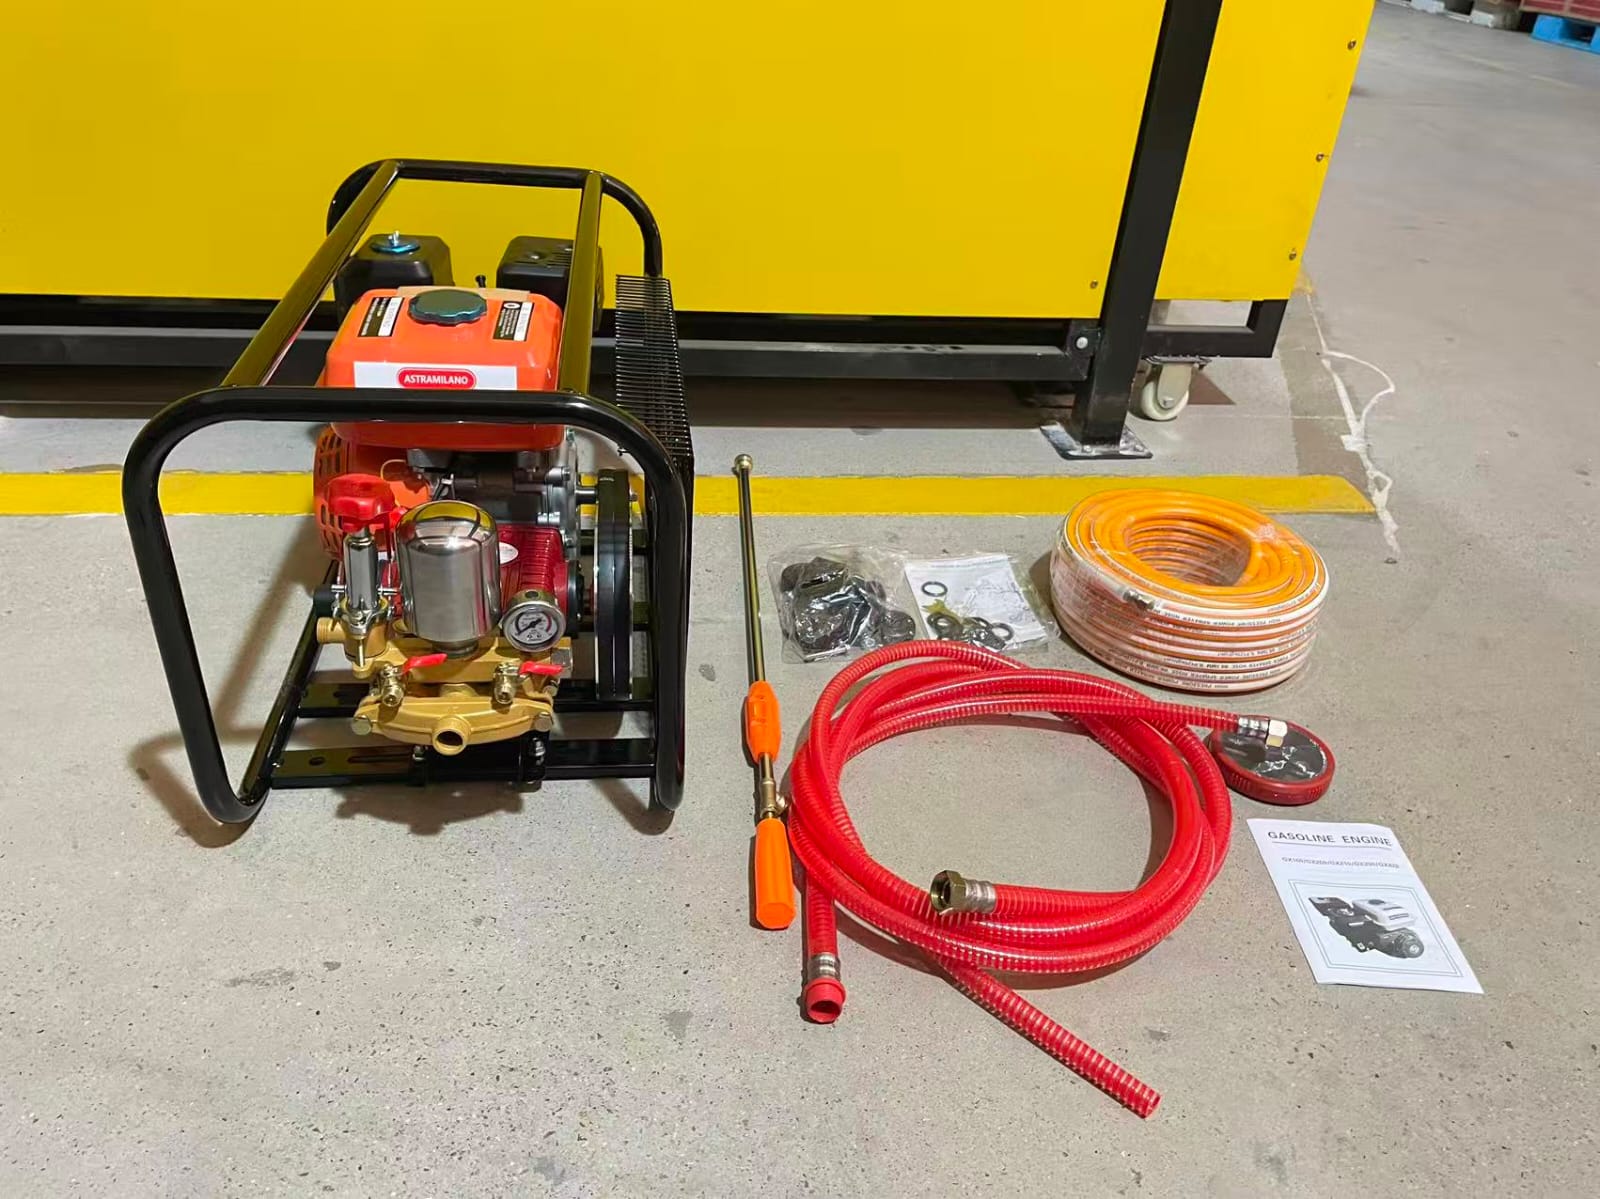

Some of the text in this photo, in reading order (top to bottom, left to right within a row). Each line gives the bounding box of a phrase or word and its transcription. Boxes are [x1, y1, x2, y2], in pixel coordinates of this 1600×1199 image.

[403, 374, 469, 386] ASTRAMILANO
[1267, 831, 1393, 847] GASOLINE ENGINE
